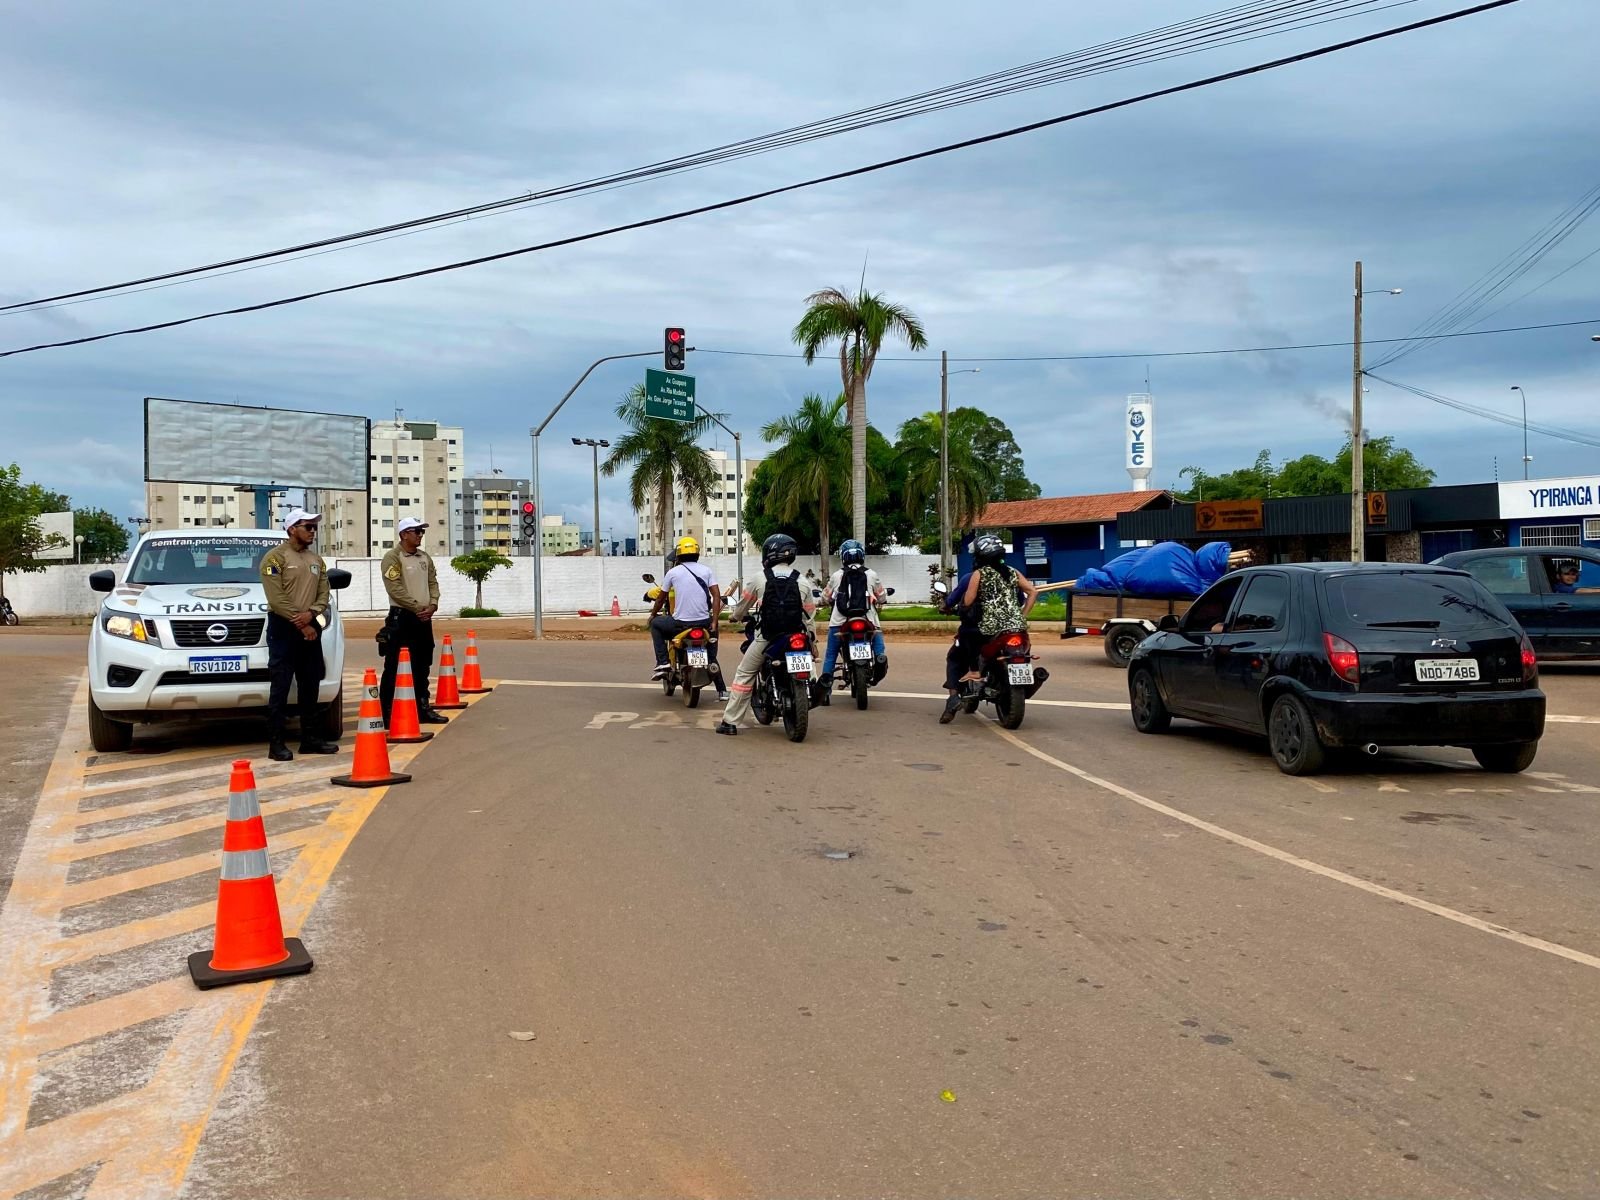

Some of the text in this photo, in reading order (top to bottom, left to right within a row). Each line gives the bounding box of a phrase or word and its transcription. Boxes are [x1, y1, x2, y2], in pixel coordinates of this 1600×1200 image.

[1131, 429, 1145, 466] YEC
[1528, 485, 1593, 508] YPIRANGA
[151, 537, 285, 548] semtran.portovelho.ro.gov.
[193, 661, 241, 673] RSV1D28
